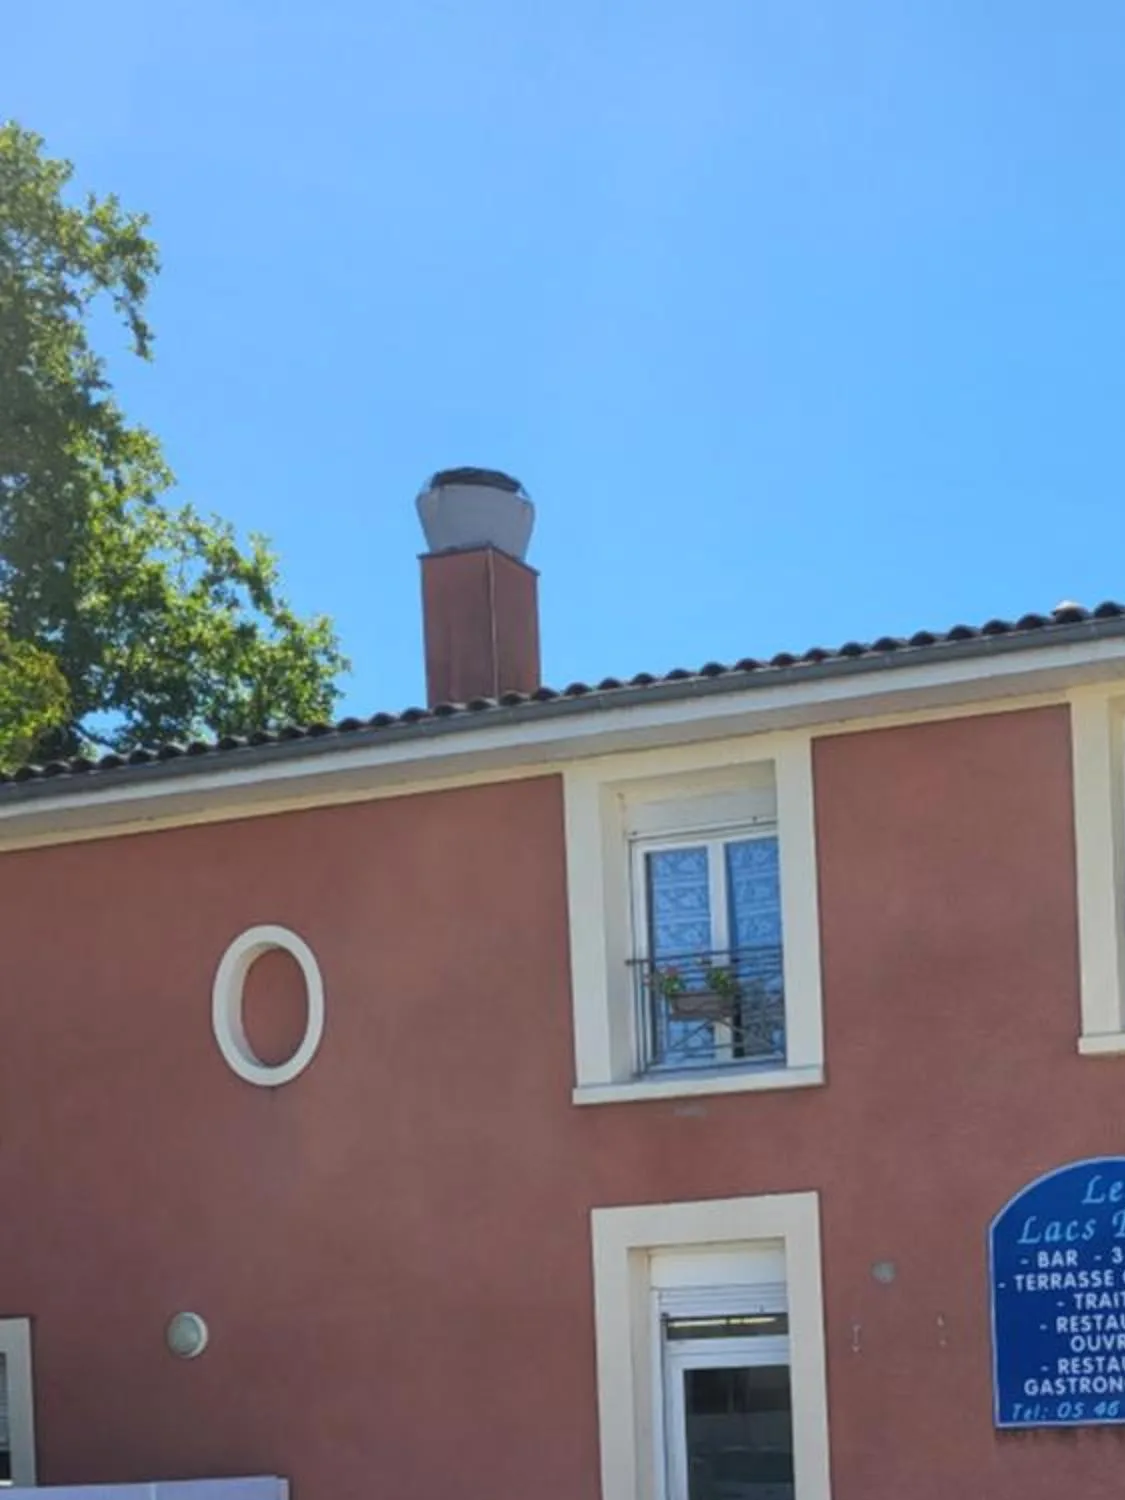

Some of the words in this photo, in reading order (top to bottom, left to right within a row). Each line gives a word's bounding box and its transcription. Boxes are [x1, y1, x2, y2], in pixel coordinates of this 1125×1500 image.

[1017, 1216, 1097, 1245] Lacs
[1037, 1249, 1079, 1268] BAR
[1111, 1246, 1124, 1264] 3
[1014, 1268, 1115, 1292] TERRASSE
[1056, 1401, 1084, 1419] 05
[1093, 1400, 1121, 1418] 46
